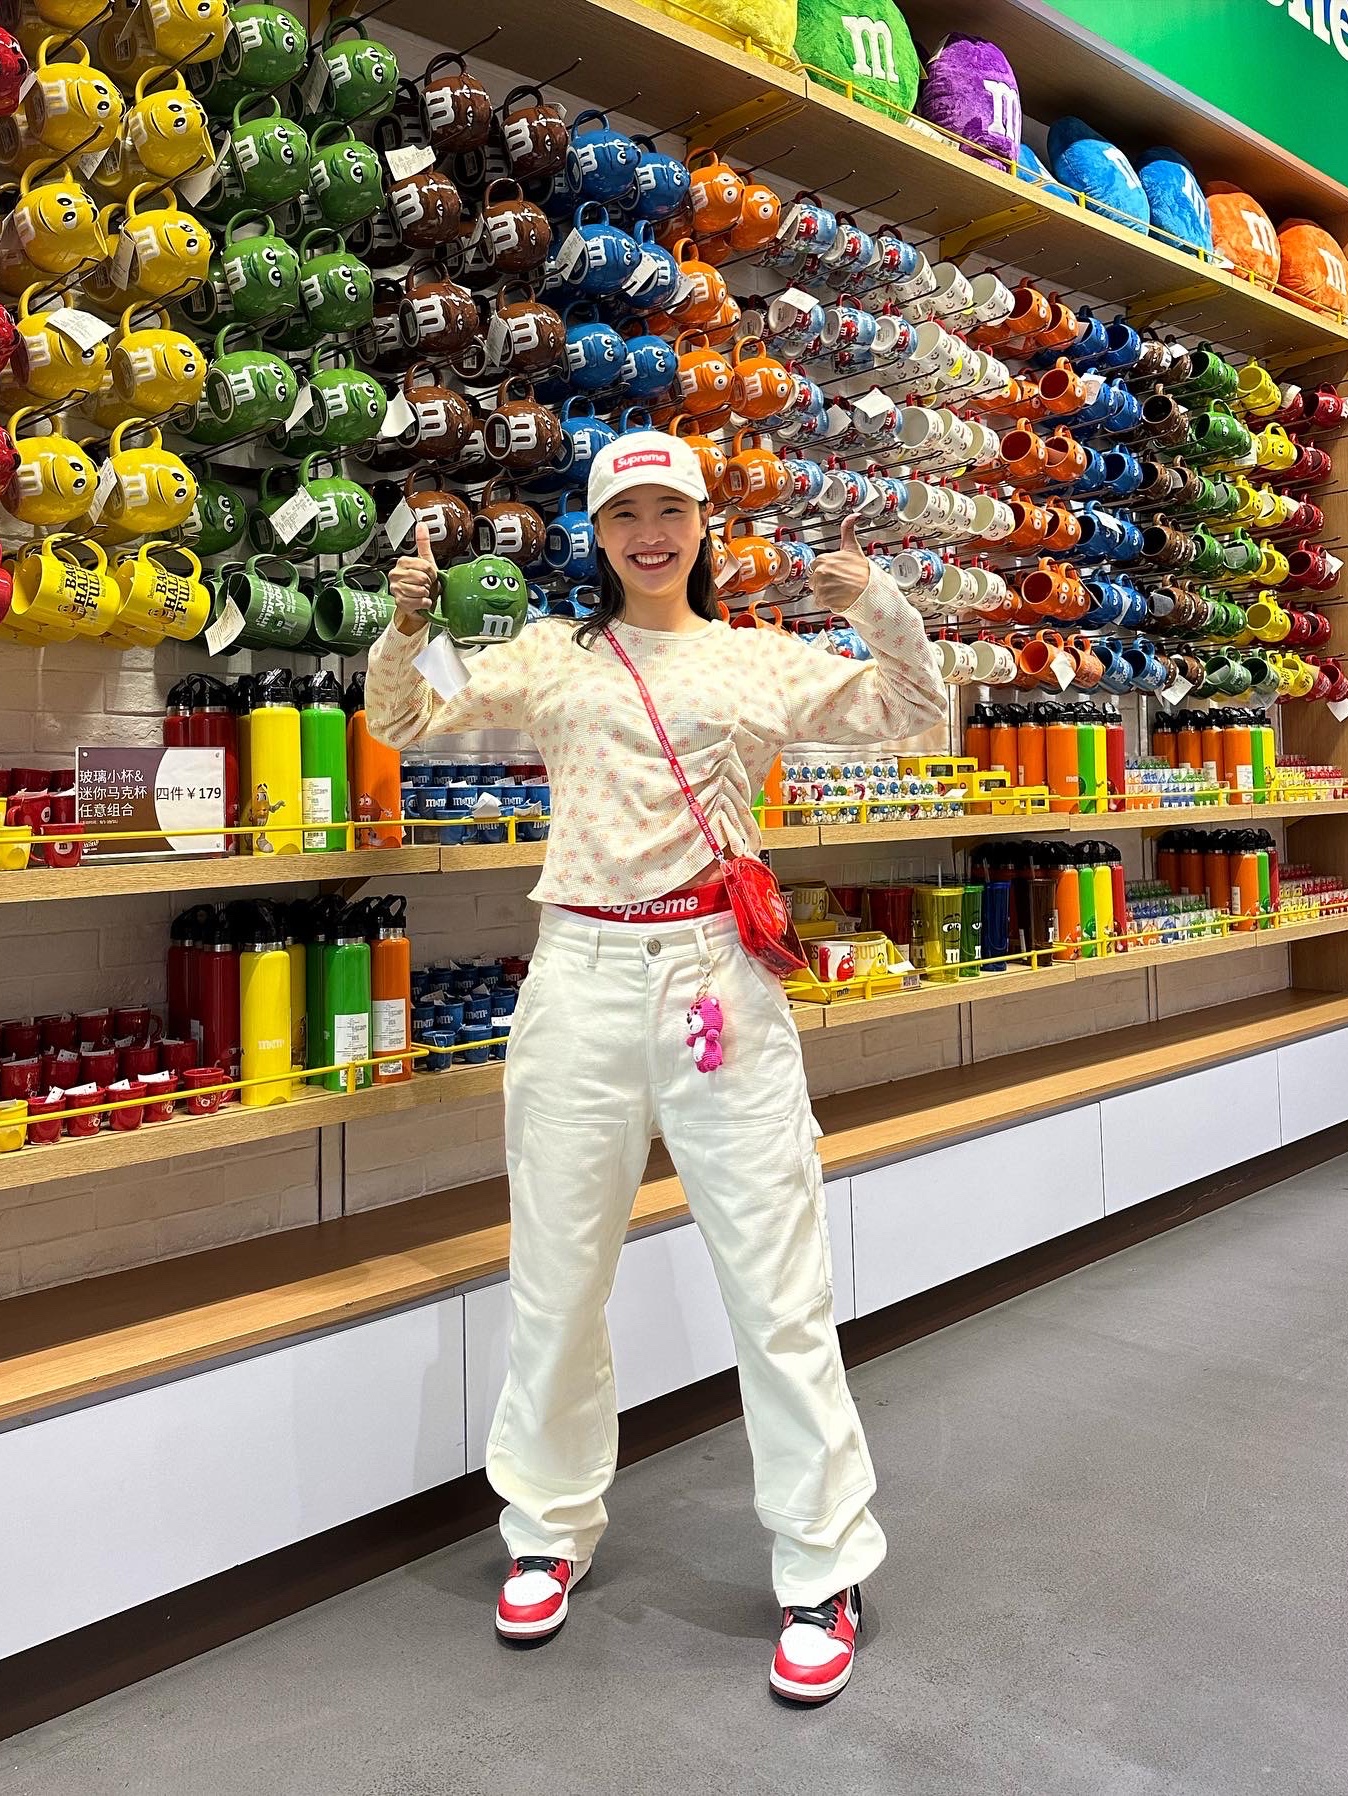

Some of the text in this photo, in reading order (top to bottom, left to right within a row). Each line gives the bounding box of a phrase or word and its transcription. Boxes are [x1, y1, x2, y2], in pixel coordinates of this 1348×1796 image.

[239, 20, 262, 52] m
[841, 16, 899, 84] m
[329, 54, 352, 86] m
[42, 80, 68, 115] m
[426, 88, 454, 130] m
[984, 80, 1021, 144] m
[128, 112, 148, 146] m
[504, 119, 530, 161] m
[236, 136, 260, 172] m
[577, 145, 598, 175] m
[310, 160, 331, 195] m
[636, 165, 656, 193] m
[392, 183, 424, 229] m
[690, 184, 708, 212] m
[15, 207, 36, 245] m
[487, 211, 518, 254] m
[1240, 209, 1278, 259] m
[134, 230, 160, 267] m
[587, 238, 606, 268] m
[224, 257, 247, 292] m
[657, 259, 670, 286] m
[1318, 248, 1347, 295] m
[301, 278, 324, 310] m
[694, 273, 709, 304] m
[414, 295, 445, 340] m
[511, 315, 539, 354] m
[24, 337, 50, 368] m
[131, 349, 155, 381] m
[568, 341, 586, 371] m
[621, 353, 637, 381] m
[232, 373, 256, 405] m
[679, 370, 698, 395] m
[745, 373, 762, 398] m
[324, 387, 348, 419] m
[418, 401, 447, 440] m
[510, 415, 536, 452] m
[574, 432, 591, 461] m
[616, 452, 668, 470] Supreme
[17, 463, 44, 497] m
[123, 473, 148, 506] m
[750, 467, 766, 490] m
[316, 501, 338, 531] m
[416, 505, 447, 541] m
[497, 517, 523, 552] m
[572, 532, 589, 559] m
[738, 555, 756, 581] m
[481, 613, 513, 636] m
[80, 769, 144, 783] 玻璃小杯&
[79, 785, 148, 800] 迷你马克杯
[79, 803, 135, 817] 任意组合
[945, 949, 960, 963] m
